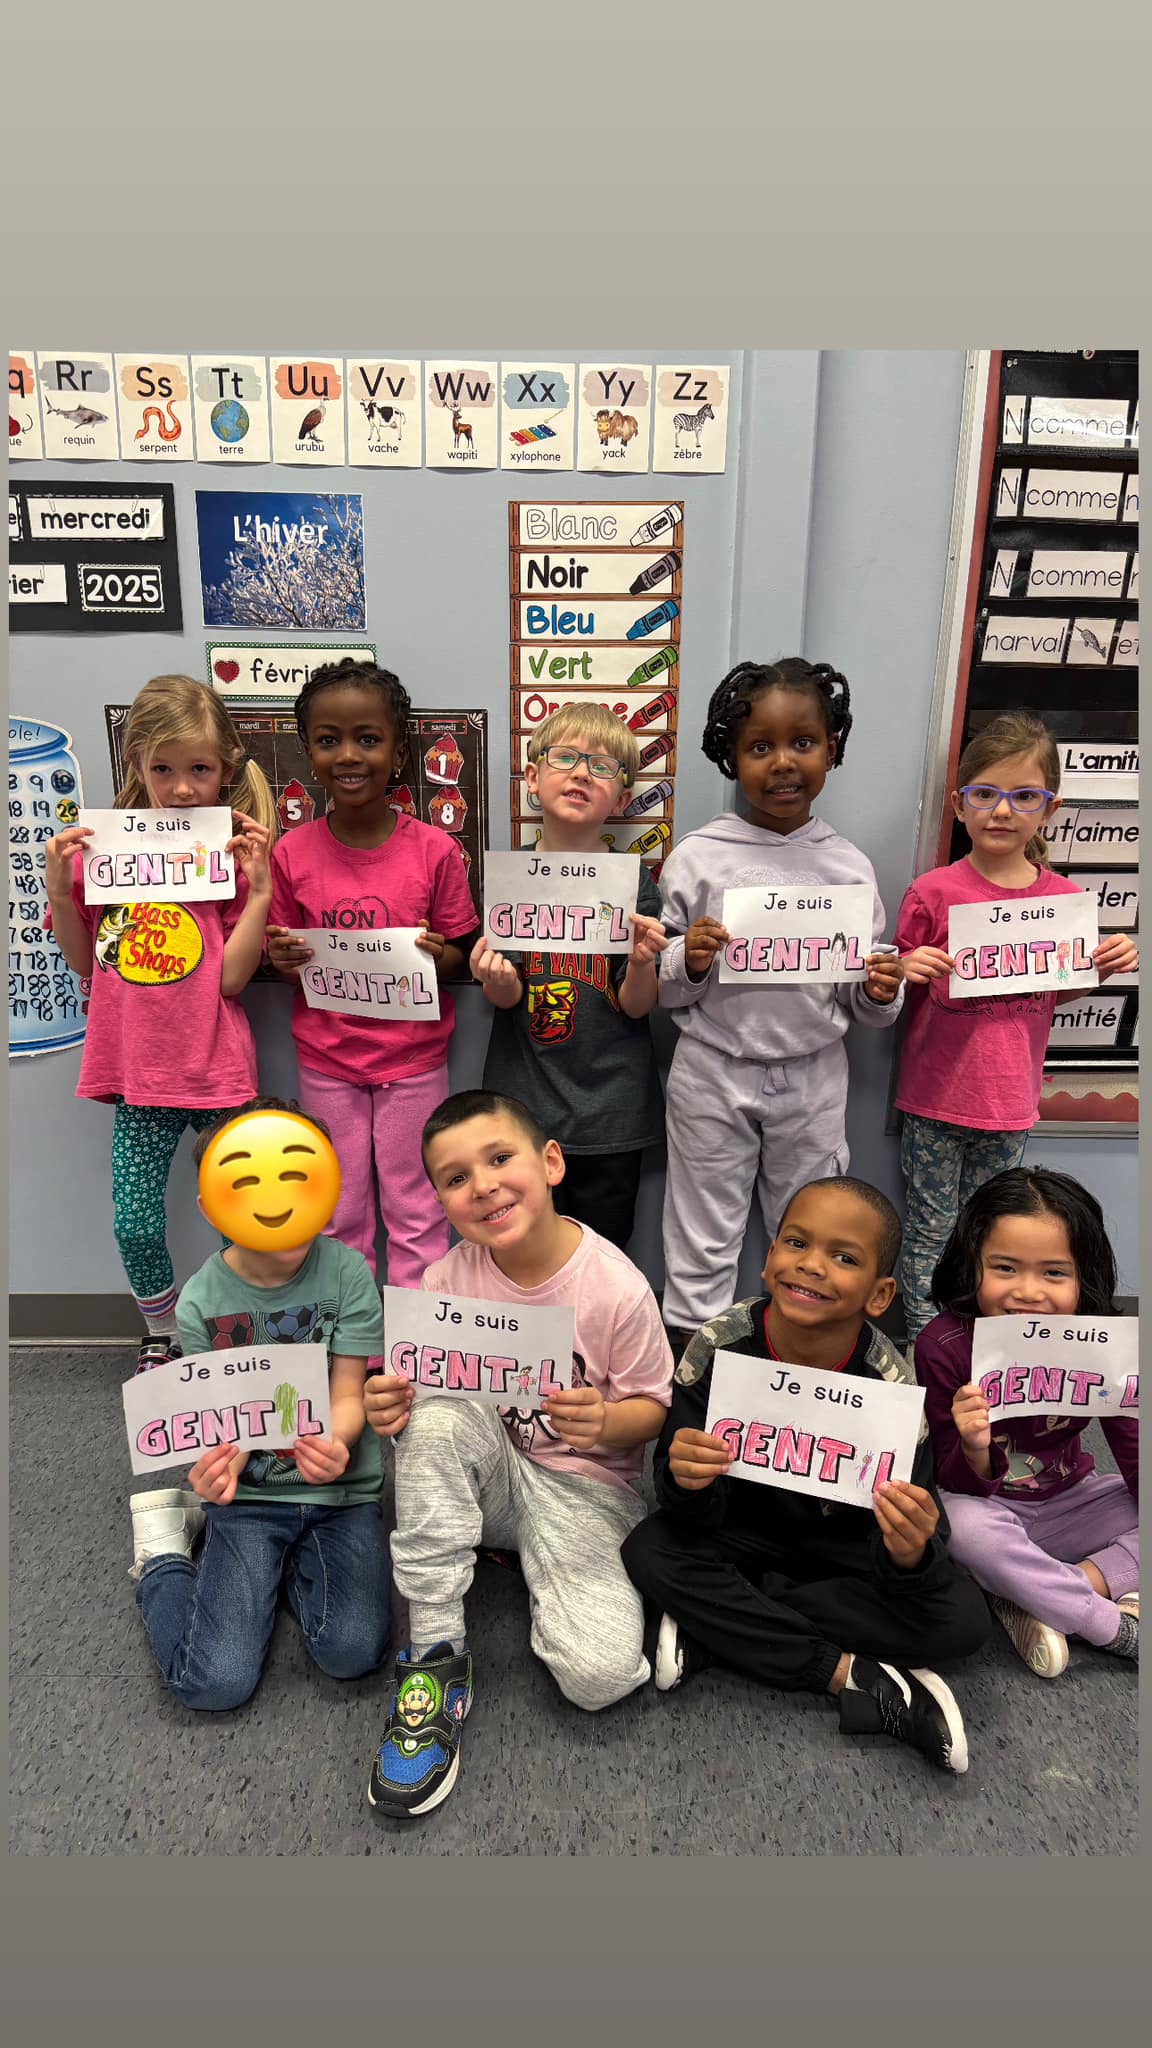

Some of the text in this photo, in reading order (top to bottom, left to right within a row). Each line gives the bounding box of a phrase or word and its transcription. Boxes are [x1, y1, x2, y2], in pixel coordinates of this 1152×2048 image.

[56, 361, 93, 391] Rr
[136, 367, 173, 397] Ss
[211, 368, 243, 399] Tt
[288, 366, 328, 397] Uu
[359, 367, 406, 397] Vv
[433, 372, 491, 401] Ww
[673, 373, 708, 401] Zz
[517, 374, 556, 403] Xx
[598, 371, 635, 406] Yy
[1004, 408, 1022, 436] N
[1030, 416, 1125, 437] comme
[63, 434, 95, 448] requin
[139, 443, 177, 455] serpent
[218, 445, 243, 455] terre
[295, 442, 325, 452] urubu
[368, 443, 399, 454] vache
[447, 449, 478, 461] wapiti
[510, 452, 561, 463] xylophone
[602, 448, 626, 460] yack
[673, 448, 702, 460] zèbre
[999, 476, 1018, 505] N
[1026, 487, 1118, 510] comme
[41, 509, 150, 530] mercredi
[233, 515, 329, 546] L'hiver
[526, 508, 617, 540] Blanc
[527, 555, 589, 589] Noir
[993, 561, 1014, 589] N
[1031, 567, 1122, 587] comme
[85, 575, 160, 602] 2025
[527, 604, 594, 635] Bleu
[985, 627, 1065, 654] narval
[250, 658, 309, 683] févri
[528, 649, 593, 680] Vert
[524, 694, 628, 724] Ore
[239, 721, 260, 730] mardi
[431, 723, 456, 732] samedi
[438, 754, 447, 776] 1
[30, 775, 44, 792] 9
[33, 801, 50, 817] 19
[57, 803, 79, 818] 20
[286, 799, 302, 820] 5
[441, 803, 454, 825] 8
[10, 827, 54, 843] 28 29
[124, 816, 191, 832] Je suis
[1039, 818, 1073, 842] ut
[10, 853, 34, 872] 38
[528, 858, 597, 877] Je suis
[15, 875, 39, 895] 48
[1086, 881, 1137, 908] der
[19, 900, 39, 921] 58
[765, 893, 833, 910] Je suis
[130, 903, 182, 930] Bass
[321, 909, 376, 929] NON
[989, 906, 1056, 923] Je suis
[21, 927, 43, 944] 68
[127, 921, 167, 948] Pro
[329, 935, 392, 953] Je suis
[24, 950, 47, 971] 78
[125, 943, 187, 979] Shops
[28, 973, 51, 998] 88
[53, 973, 76, 995] 89
[30, 997, 53, 1021] 98
[54, 994, 78, 1019] 99
[435, 1301, 519, 1332] Je suis
[1023, 1321, 1109, 1343] Je suis
[180, 1357, 271, 1382] Je suis
[770, 1371, 864, 1408] Je suis
